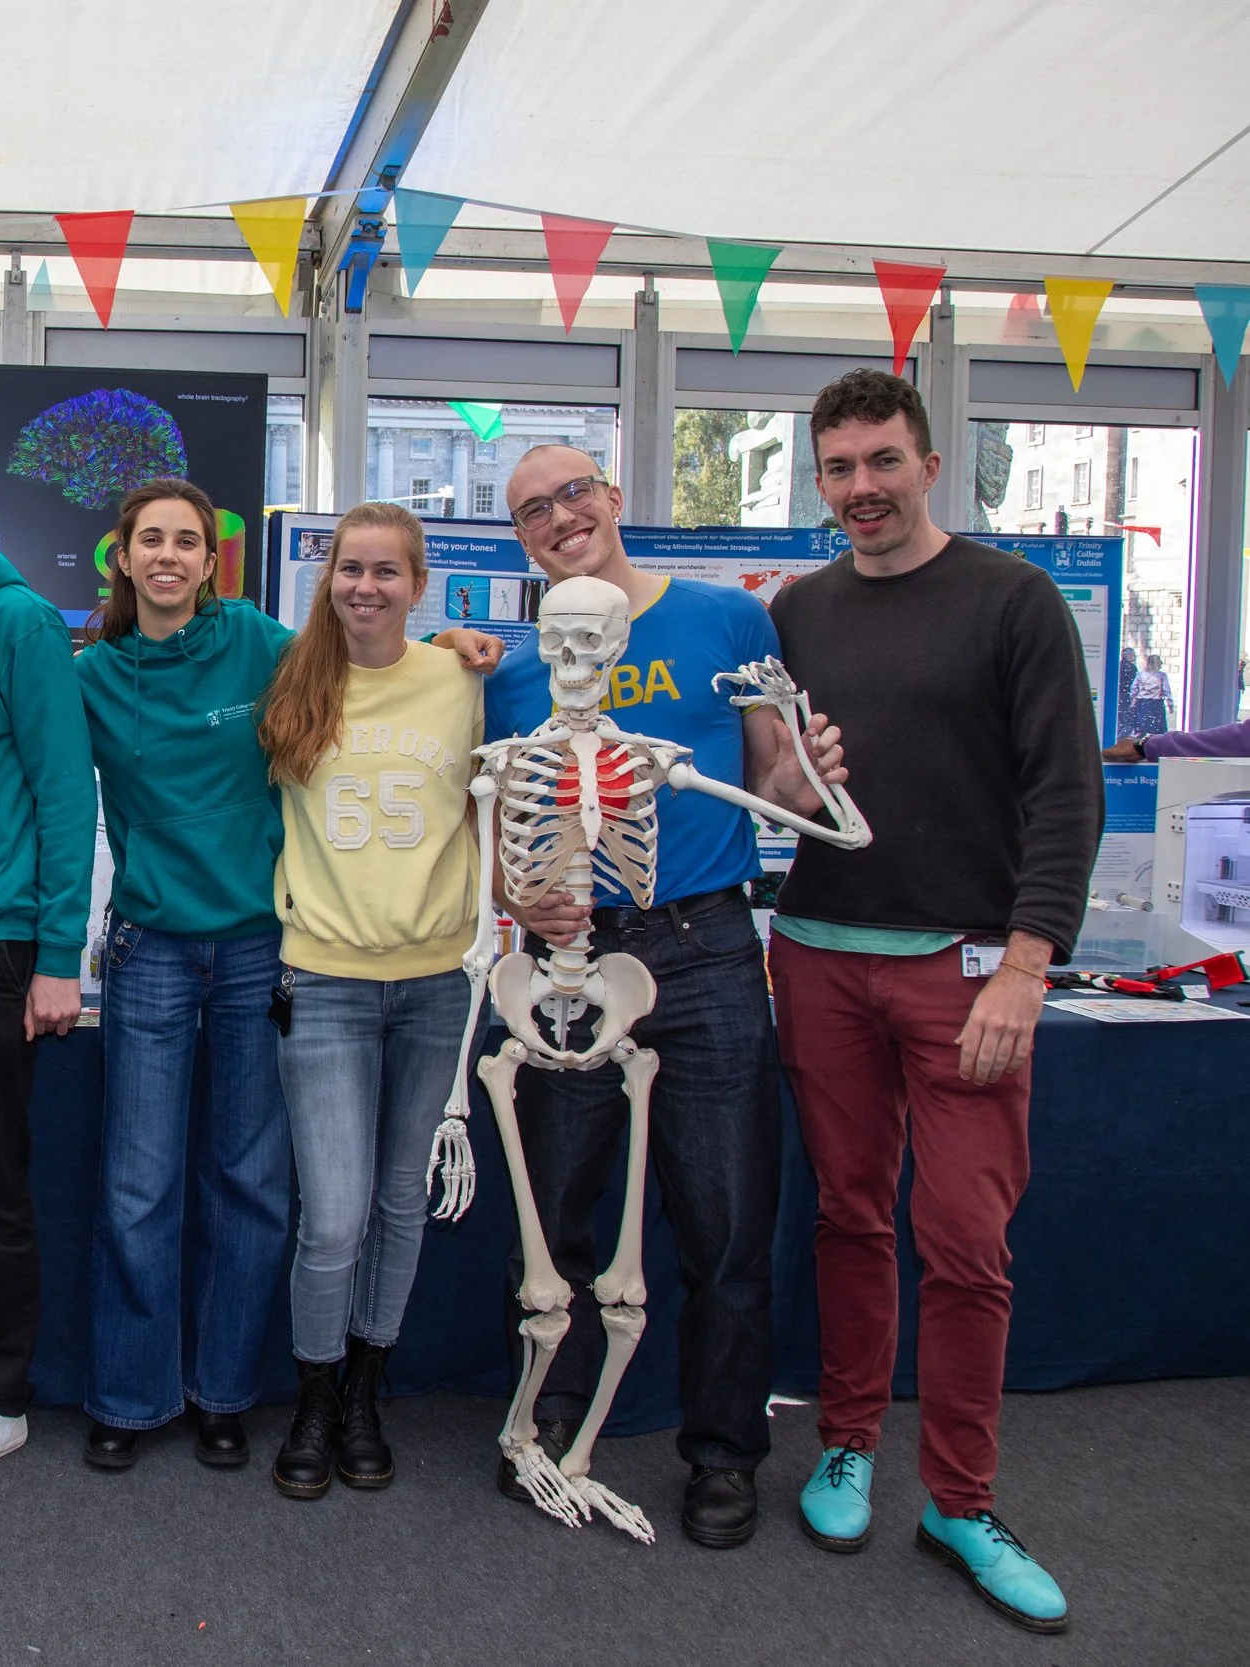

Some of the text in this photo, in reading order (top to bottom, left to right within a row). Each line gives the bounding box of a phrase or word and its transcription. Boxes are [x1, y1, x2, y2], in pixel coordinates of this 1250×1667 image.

[432, 541, 449, 551] help
[470, 543, 497, 552] bones!
[1078, 542, 1102, 550] Trinity
[1077, 550, 1103, 558] College
[1124, 776, 1138, 784] and
[325, 772, 425, 850] 65
